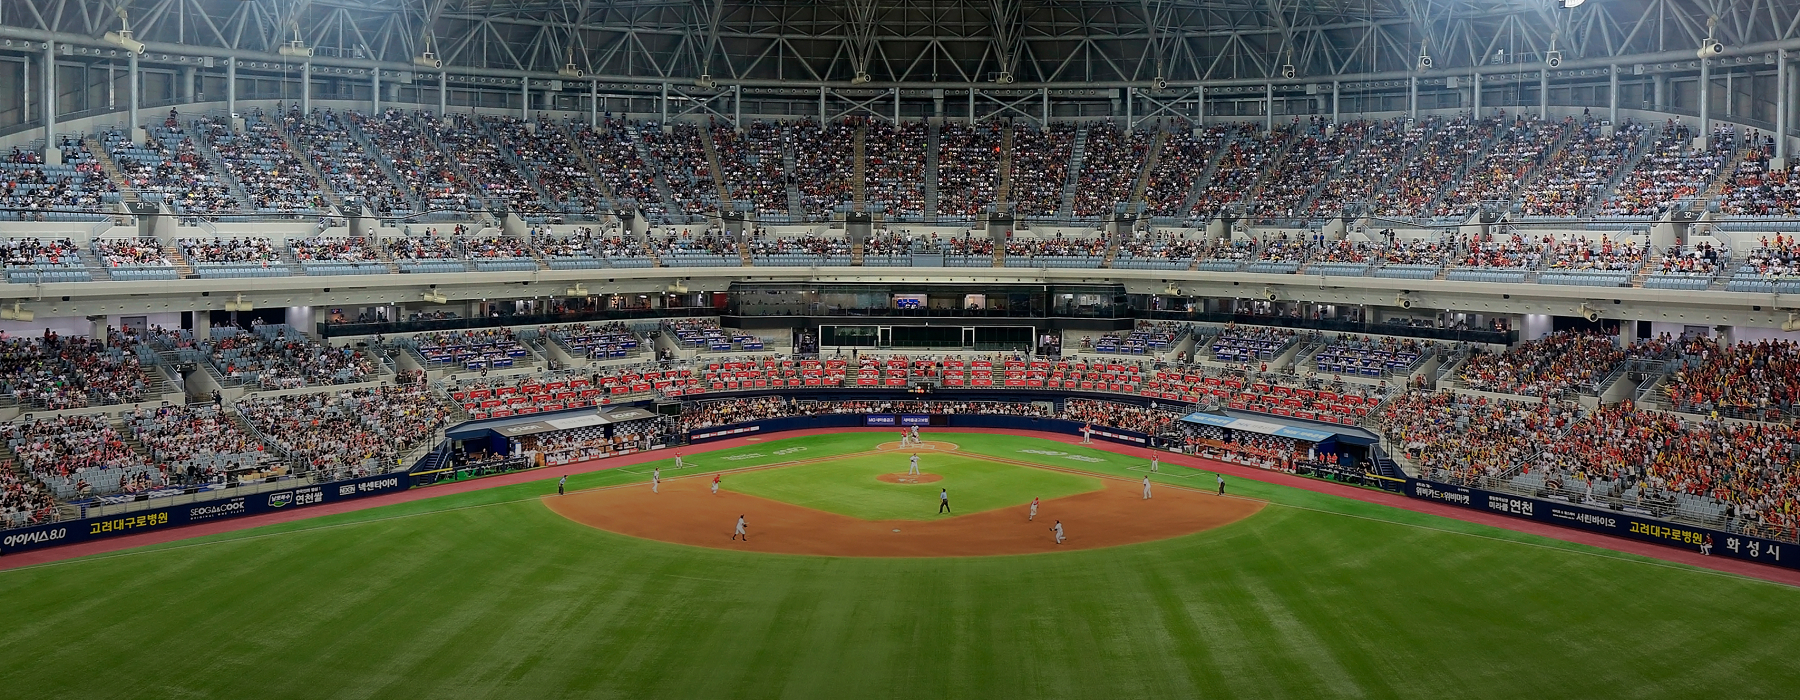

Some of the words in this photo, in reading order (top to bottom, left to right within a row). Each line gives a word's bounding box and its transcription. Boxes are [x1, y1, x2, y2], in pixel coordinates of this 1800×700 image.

[358, 478, 398, 492] 넥센타이어
[296, 492, 323, 505] 연천쌀
[1488, 501, 1508, 512] 미라클
[1510, 499, 1533, 516] 연천
[90, 512, 168, 534] 고려대구로병원
[1576, 513, 1616, 527] 서린바이오
[4, 531, 49, 546] 아이시스
[50, 528, 66, 540] 8.0
[1629, 522, 1702, 545] 고려대구로병원
